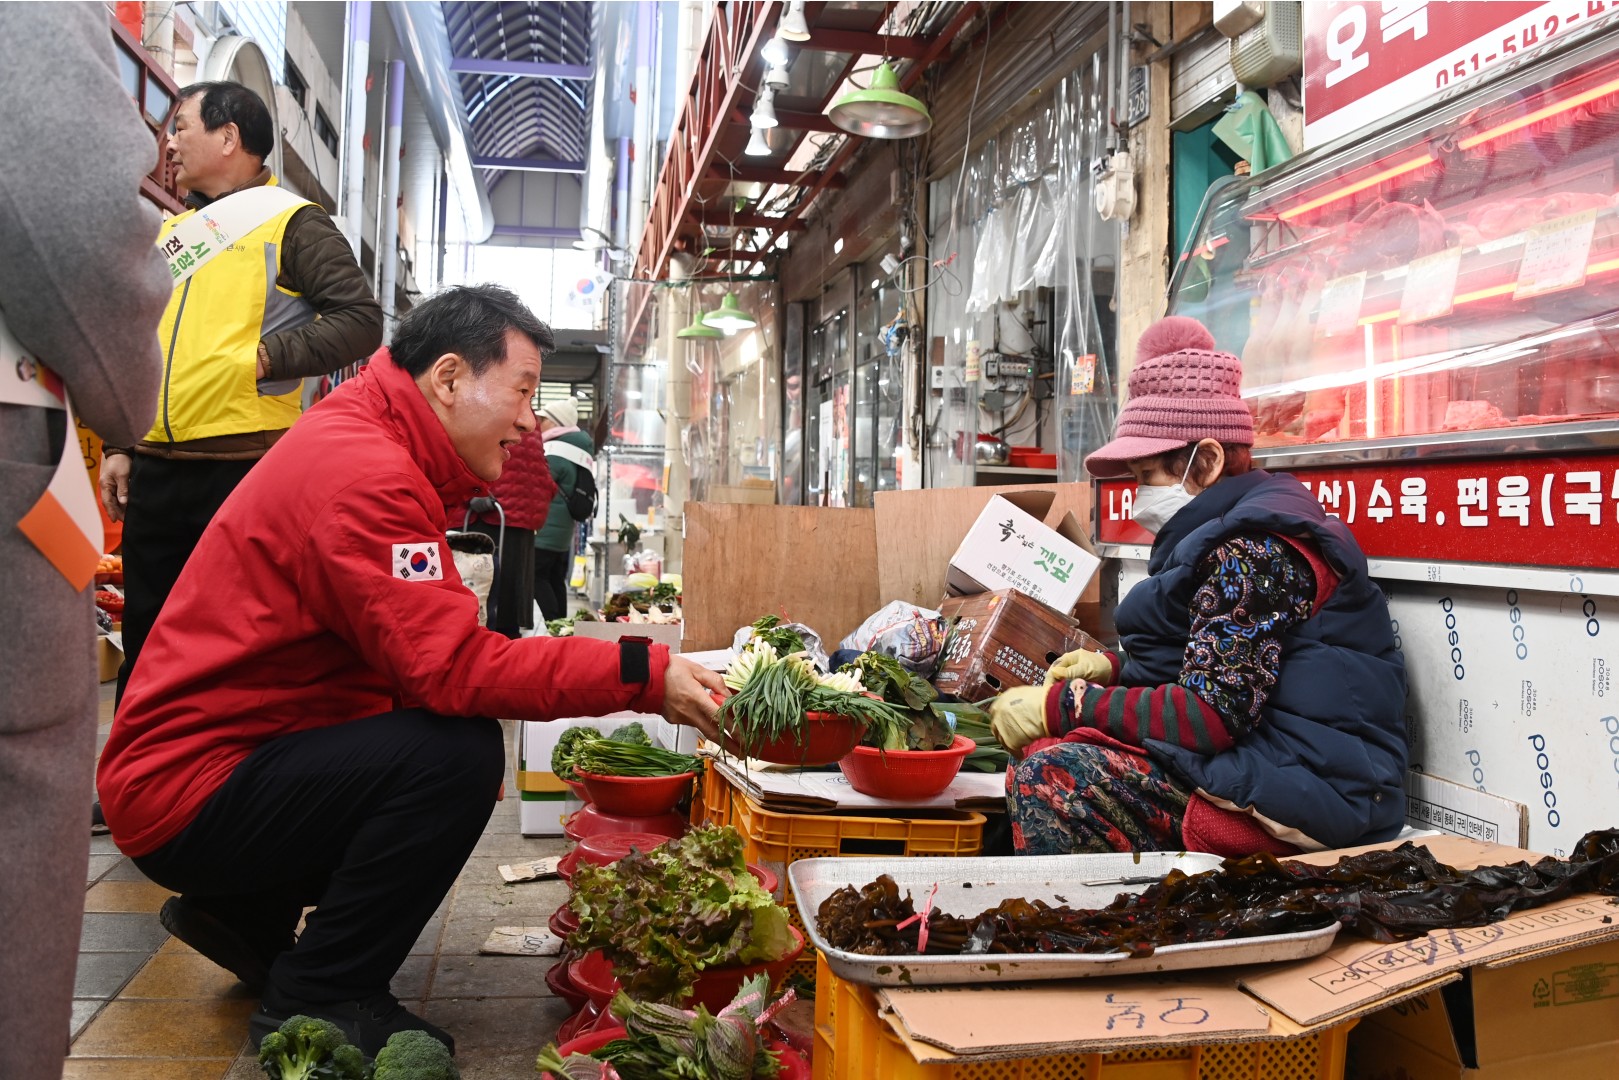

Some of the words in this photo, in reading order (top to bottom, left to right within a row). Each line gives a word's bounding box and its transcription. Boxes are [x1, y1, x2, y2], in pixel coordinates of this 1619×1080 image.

[1436, 2, 1619, 89] 051-542-4
[162, 236, 183, 259] 전
[1033, 546, 1074, 584] 깻잎
[1438, 596, 1465, 680] posco
[1528, 733, 1560, 828] posco
[1540, 911, 1569, 925] 10
